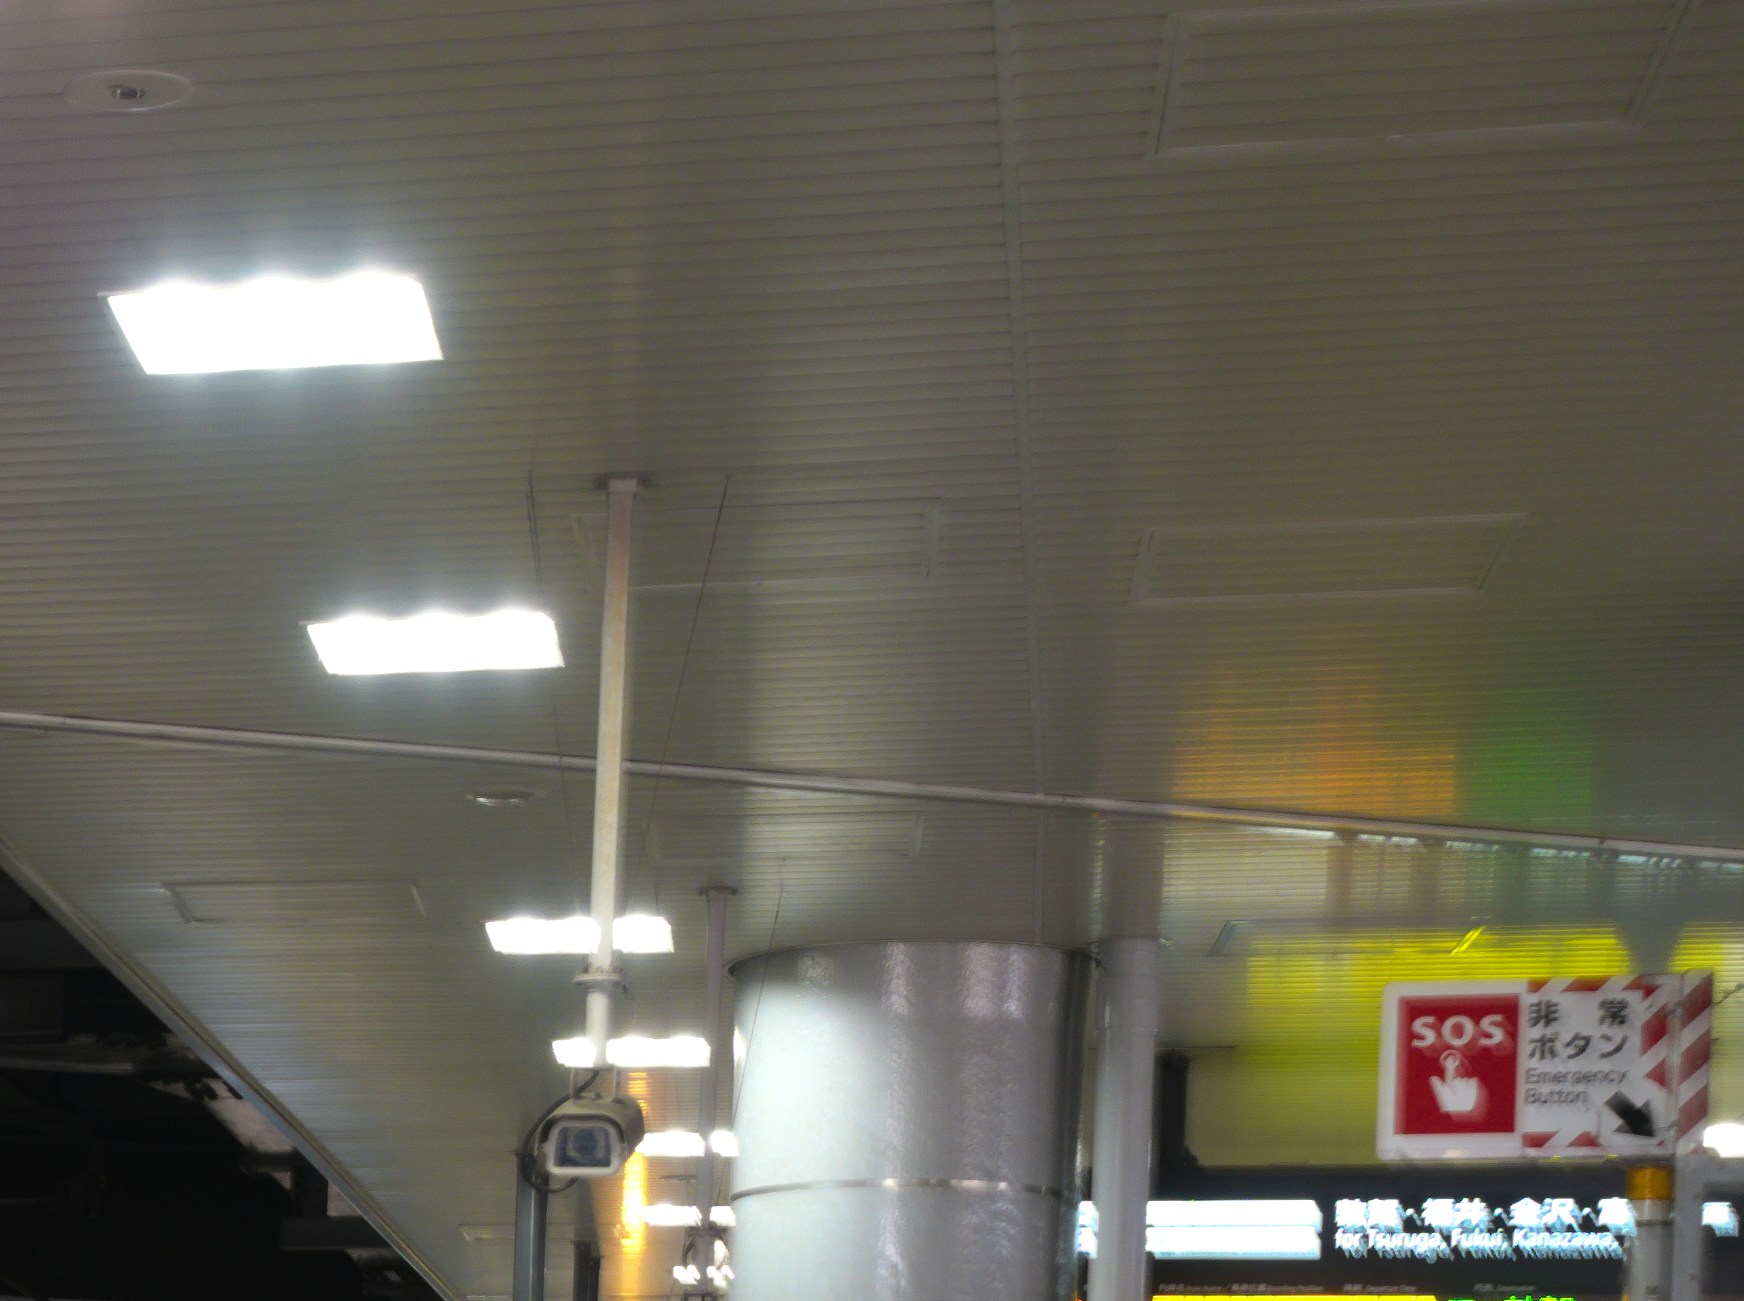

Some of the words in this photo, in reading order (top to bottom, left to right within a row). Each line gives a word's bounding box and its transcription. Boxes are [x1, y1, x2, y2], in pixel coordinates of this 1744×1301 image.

[1527, 999, 1629, 1028] 非常
[1412, 1014, 1505, 1048] SOS
[1528, 1033, 1628, 1060] ボタン
[1526, 1067, 1628, 1086] Emergency
[1525, 1088, 1588, 1105] Button
